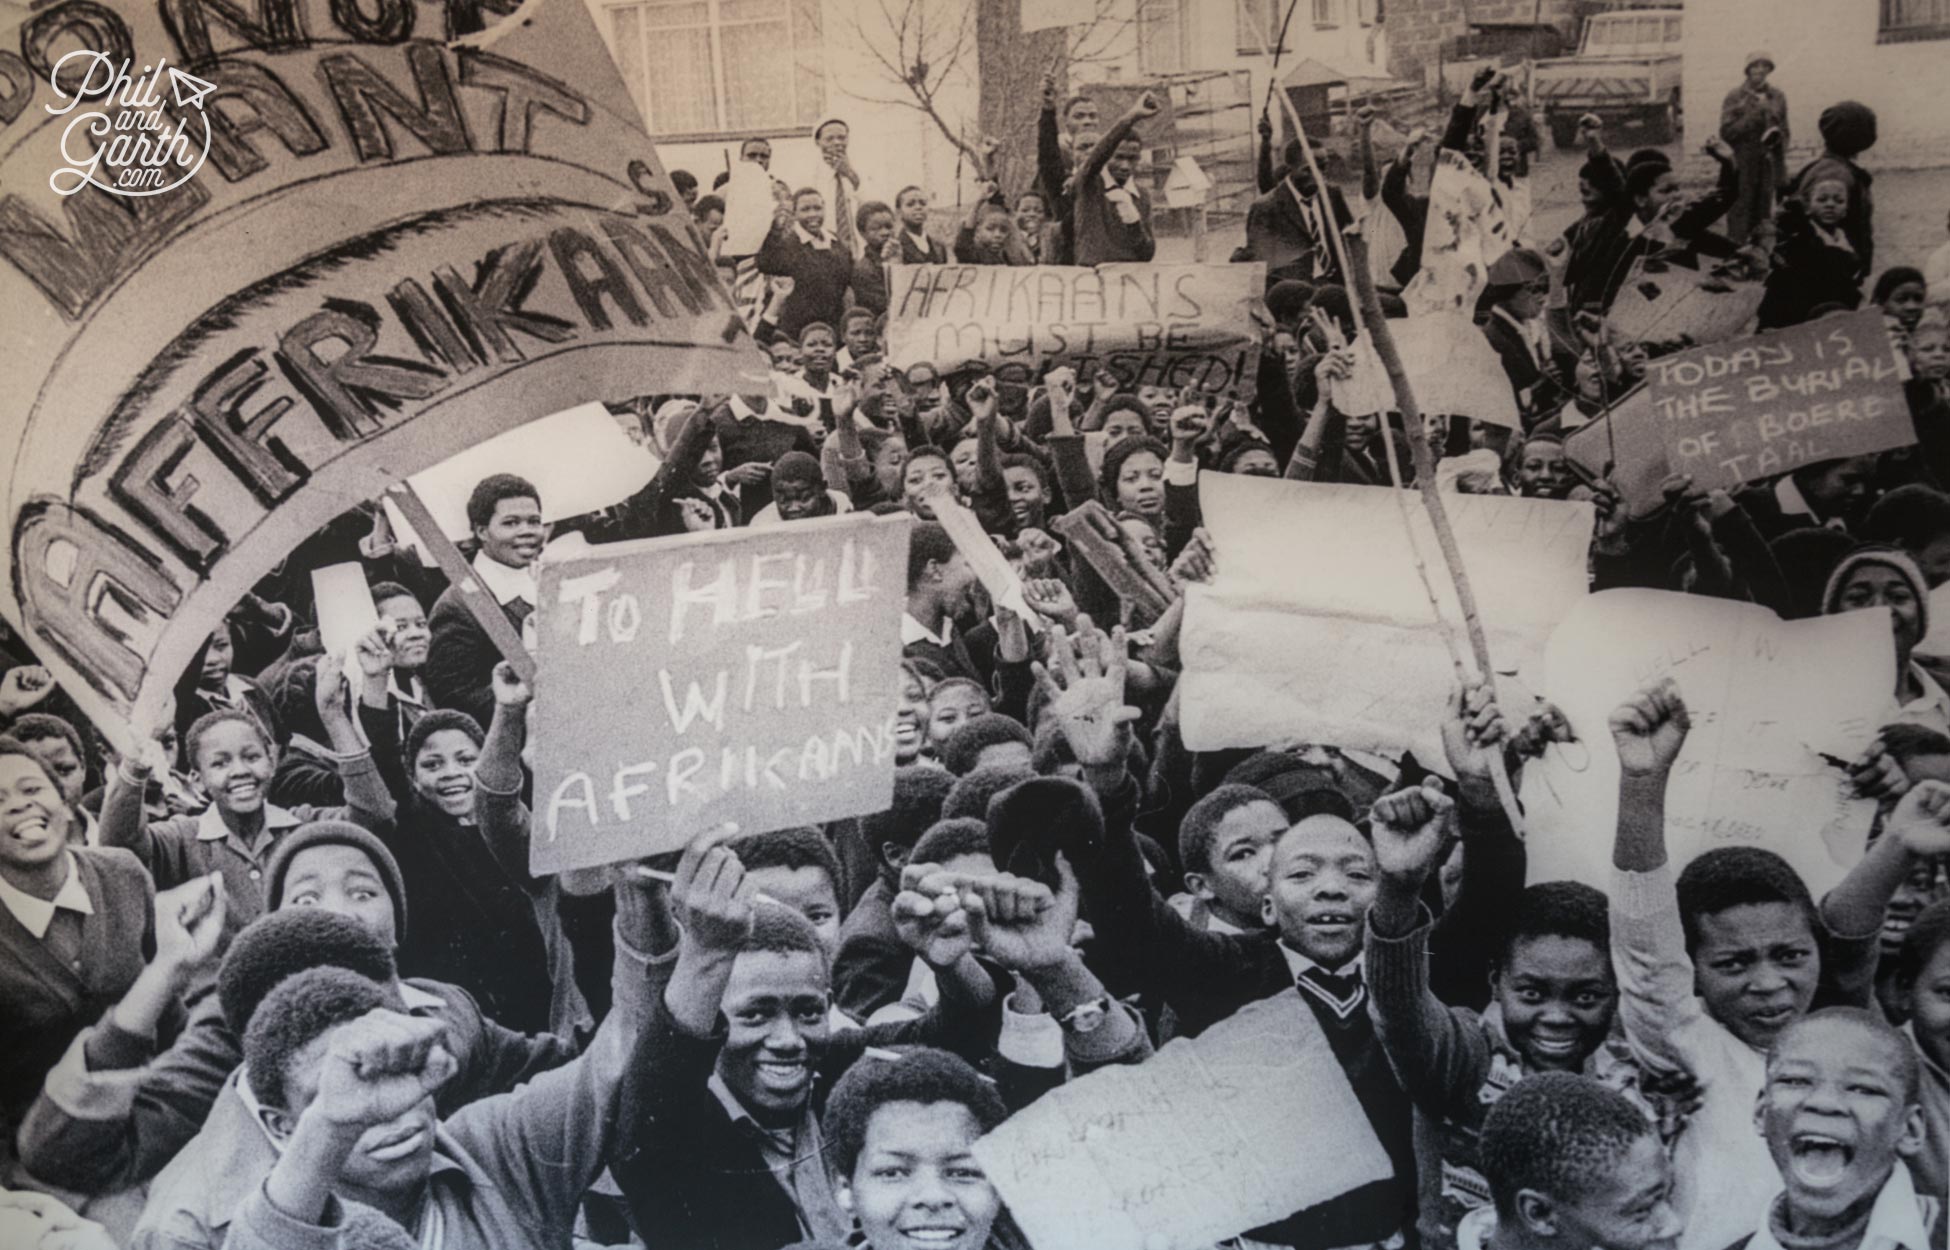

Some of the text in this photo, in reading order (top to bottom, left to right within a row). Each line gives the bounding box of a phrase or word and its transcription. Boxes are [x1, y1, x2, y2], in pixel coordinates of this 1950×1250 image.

[897, 264, 1203, 323] AFRIKAANS
[933, 321, 1203, 361] MUST BE
[1645, 328, 1854, 387] TODAY IS
[1655, 355, 1899, 420] THE BURIAL
[1677, 395, 1886, 459] OF BOERE
[1718, 438, 1831, 482] TAAL
[668, 538, 881, 646] HELL
[658, 639, 853, 735] WITH
